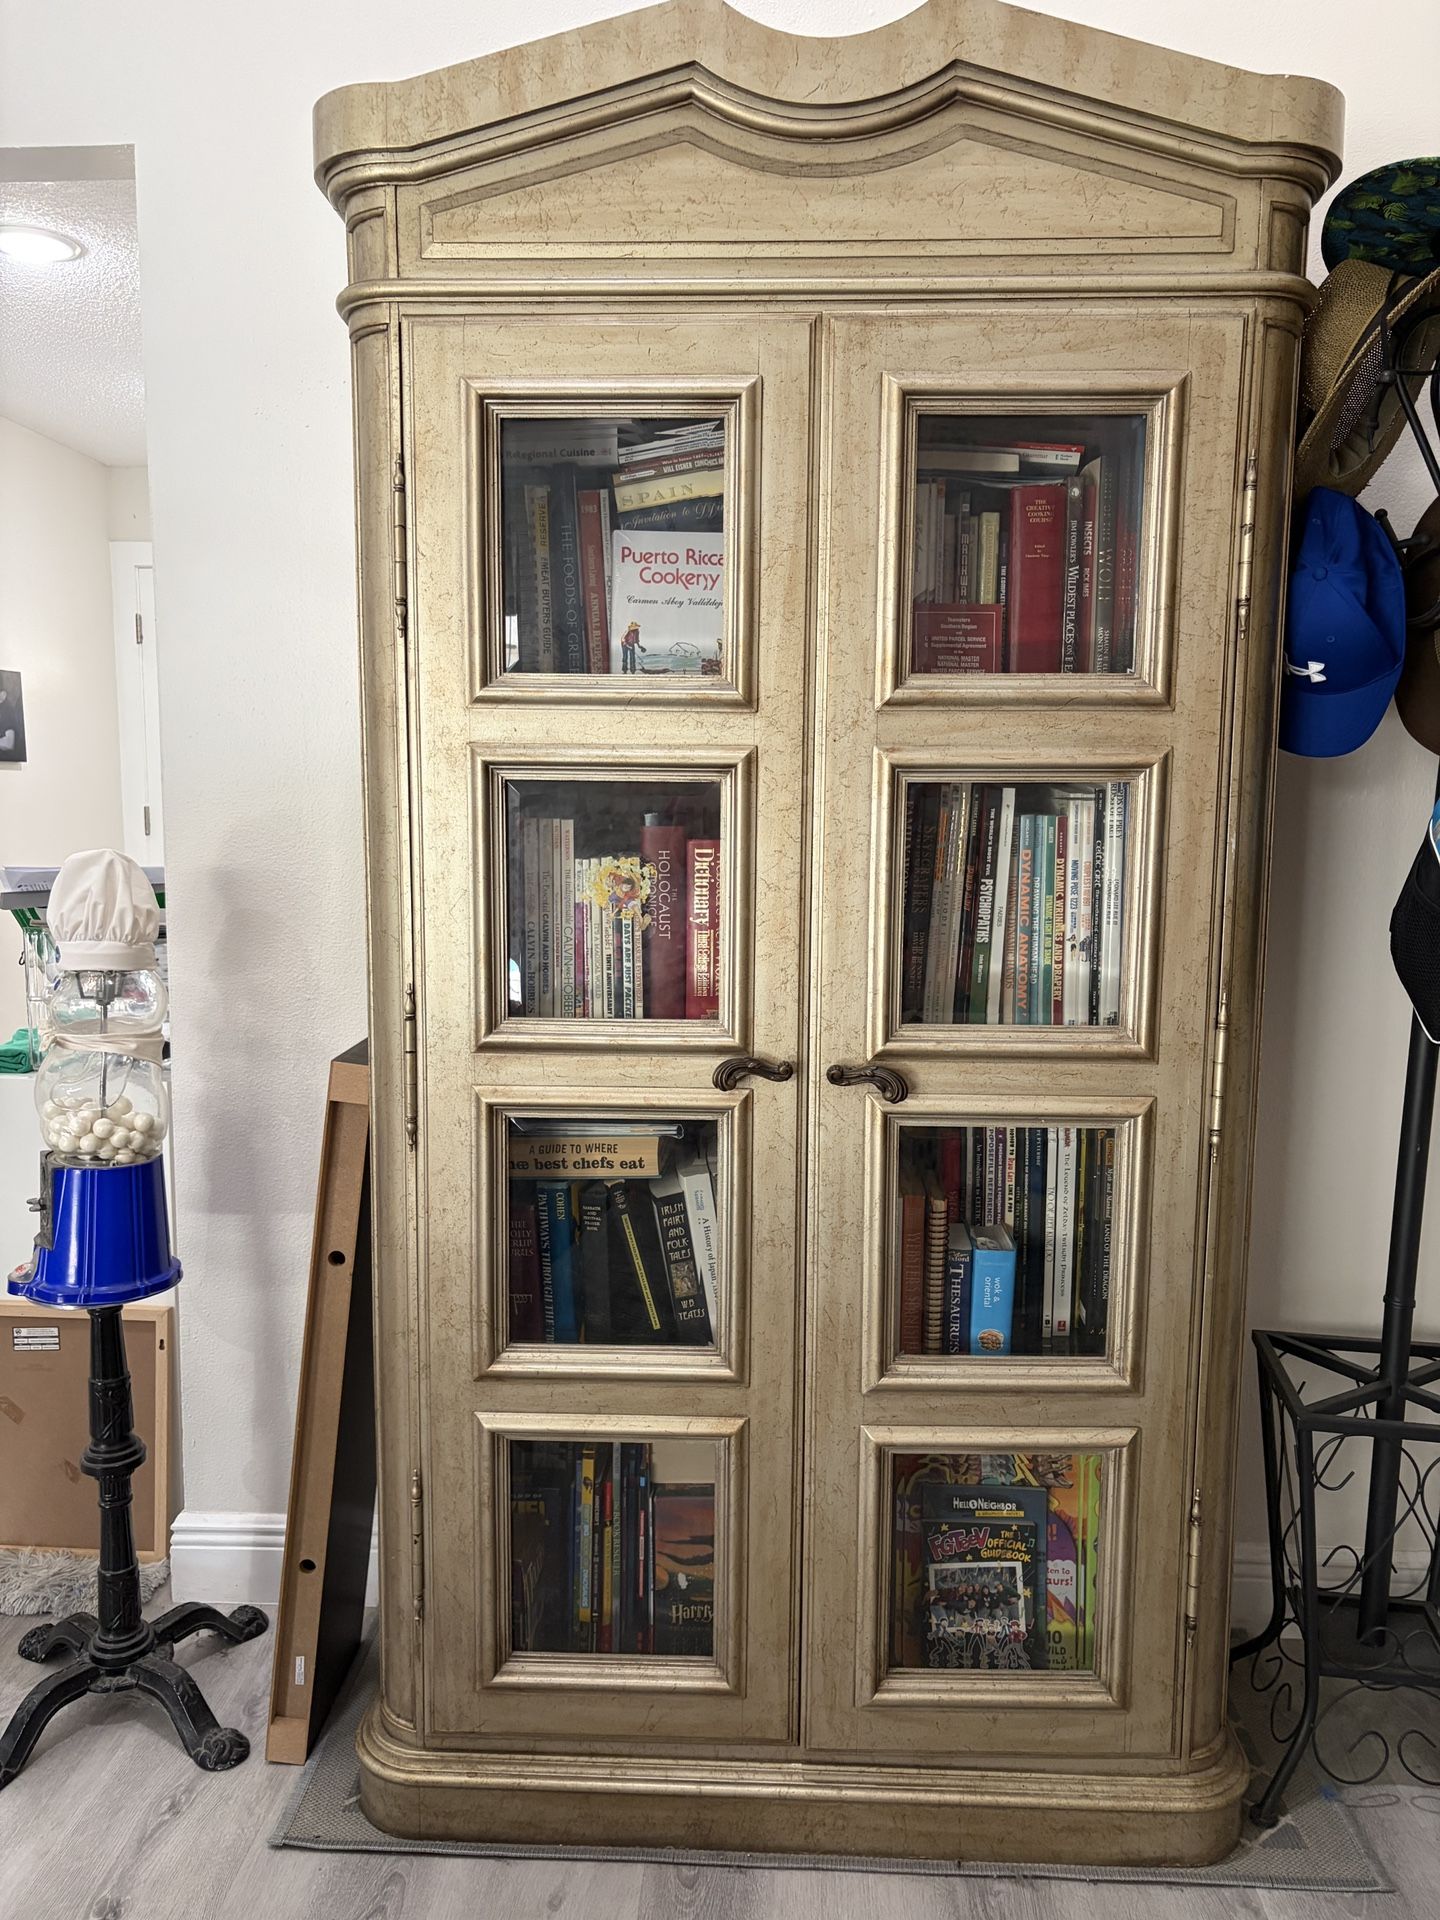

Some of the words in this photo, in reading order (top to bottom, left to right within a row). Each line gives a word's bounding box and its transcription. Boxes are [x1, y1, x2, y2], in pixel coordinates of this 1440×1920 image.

[560, 447, 595, 457] Cuisine
[621, 483, 694, 506] SPAIN
[537, 502, 547, 546] RESERVE
[632, 510, 678, 530] Invitation
[1070, 519, 1078, 532] JIM
[560, 521, 573, 552] THE
[1069, 531, 1078, 564] FOWLER'S
[1082, 520, 1093, 556] INSECTS
[620, 546, 680, 565] Puerto
[541, 559, 550, 586] MEAT
[562, 557, 577, 606] FOODS
[1066, 565, 1079, 610] WILDEST
[1082, 582, 1090, 598] IMES
[541, 589, 551, 625] BUYERS
[566, 609, 578, 627] OF
[590, 592, 603, 630] ANNUAL
[1064, 610, 1076, 644] PLACES
[542, 627, 552, 656] GUIDE
[1065, 644, 1074, 655] ON
[1116, 806, 1123, 818] OF
[987, 820, 995, 846] WORLD'S
[1115, 819, 1123, 840] PREY
[1055, 857, 1065, 899] DYNAMIC
[1070, 859, 1080, 881] MOVING
[658, 850, 671, 939] HOLOCAUST
[689, 847, 715, 927] Dictionary
[1007, 875, 1016, 917] DRAWING
[1019, 849, 1032, 928] DYNAMIC
[1031, 876, 1040, 915] DRAWING
[1070, 881, 1079, 896] POSE
[563, 881, 573, 925] Indispensable
[975, 878, 994, 943] PSYCHOPATHS
[1069, 896, 1079, 911] 1223
[541, 913, 549, 943] CALVIN
[996, 905, 1004, 928] FAERIES
[1031, 915, 1040, 931] THE
[526, 921, 536, 960] CALVIN
[563, 925, 573, 967] CALVIN
[623, 922, 632, 945] DAYS
[1006, 918, 1016, 958] DYNAMIC
[541, 943, 549, 961] AND
[623, 946, 632, 963] ARE
[634, 934, 643, 965] TREASURE
[1030, 932, 1039, 961] HUMAN
[1054, 941, 1064, 962] AND
[605, 953, 613, 971] TENTH
[1005, 959, 1014, 990] HANDS
[1017, 932, 1031, 1010] ANATOMY
[1029, 962, 1038, 984] HEAD
[541, 961, 549, 995] HOBBES
[623, 965, 632, 985] JUST
[1053, 963, 1063, 1001] DRAPERY
[528, 1145, 536, 1154] A
[538, 1144, 567, 1154] GUIDE
[570, 1144, 582, 1154] TO
[585, 1143, 619, 1154] WHERE
[534, 1157, 569, 1169] best
[572, 1156, 615, 1169] chefs
[619, 1157, 645, 1169] eat
[975, 1153, 983, 1187] Introduction
[1106, 1167, 1114, 1182] Myth
[555, 1191, 566, 1221] COHEN
[660, 1202, 685, 1216] IRISH
[986, 1177, 994, 1224] REFERENCE
[1105, 1194, 1113, 1219] Mankind
[538, 1193, 552, 1250] PATHWAYS
[667, 1227, 686, 1239] AND
[703, 1217, 709, 1225] A
[704, 1225, 713, 1250] History
[1103, 1243, 1110, 1253] OF
[707, 1250, 714, 1259] of
[1102, 1254, 1110, 1269] THE
[541, 1250, 554, 1302] THROUGH
[993, 1277, 1002, 1294] wok
[1101, 1270, 1109, 1300] DRAGON
[983, 1276, 992, 1308] oriental
[544, 1304, 555, 1327] THE
[977, 1497, 1017, 1512] NEIGHBOR
[612, 1511, 621, 1538] BOOK
[1000, 1529, 1014, 1539] THE
[980, 1548, 1032, 1563] GUIDEBOOK
[1061, 1567, 1070, 1575] to
